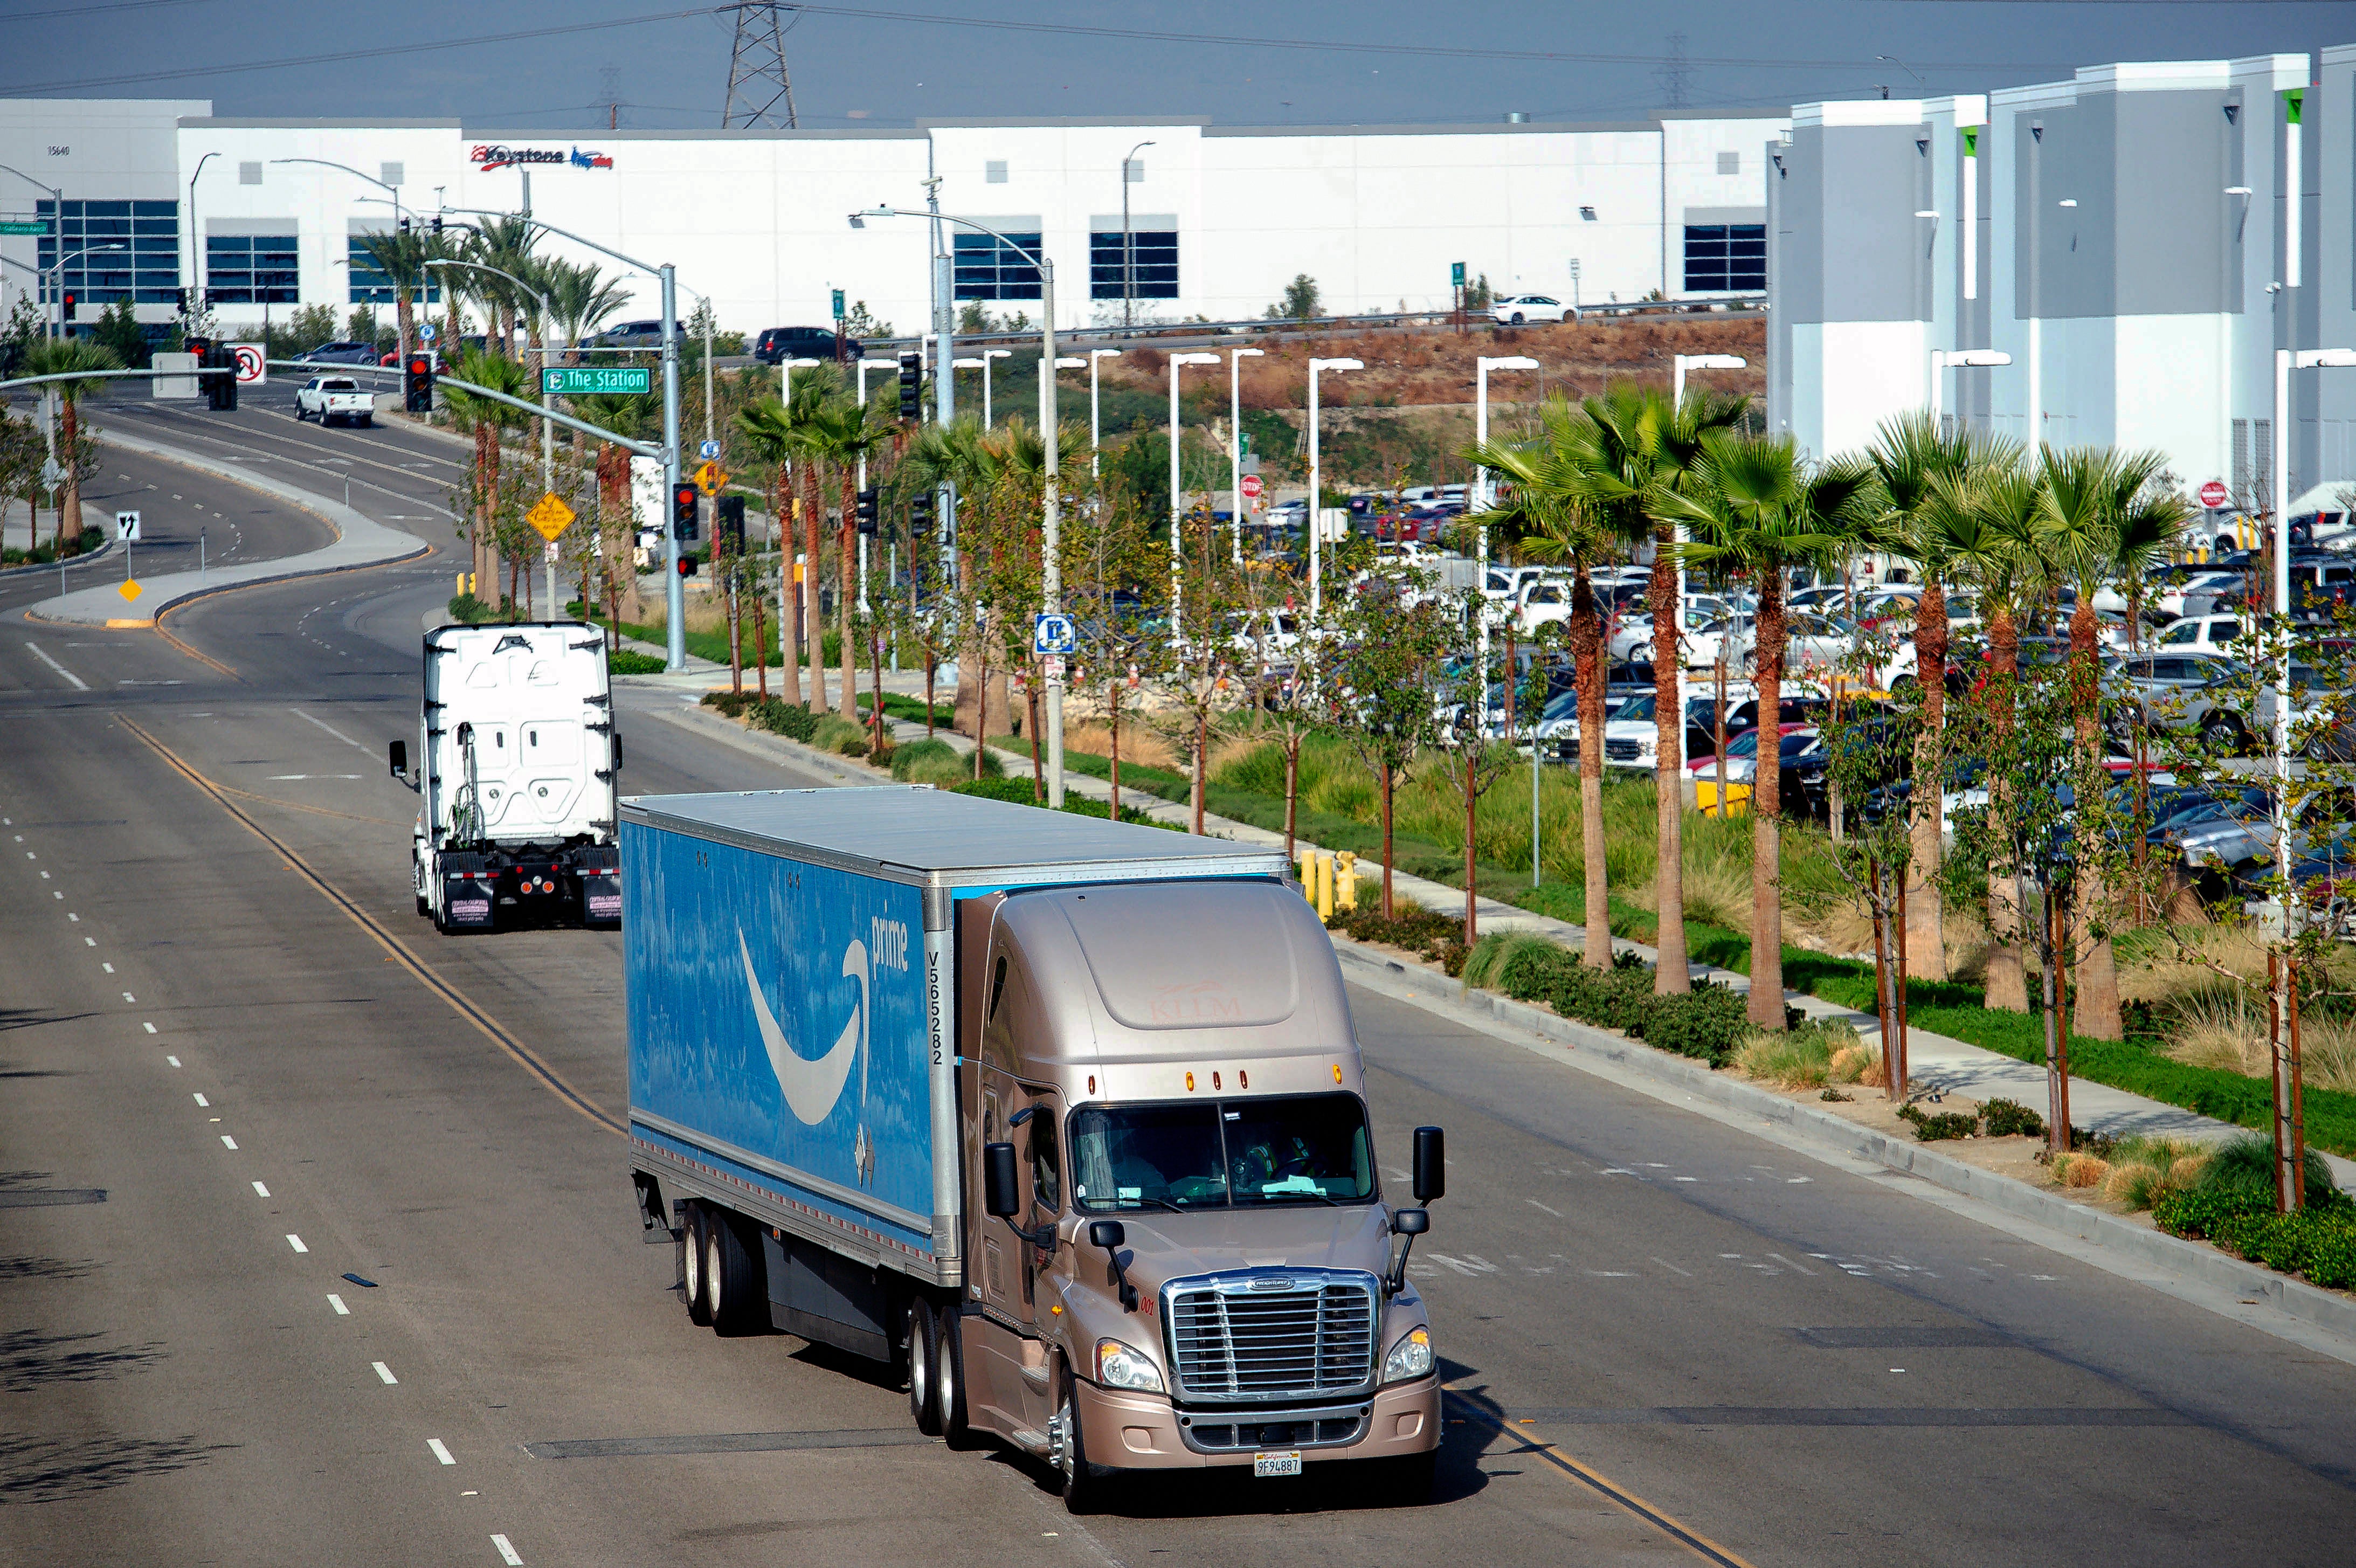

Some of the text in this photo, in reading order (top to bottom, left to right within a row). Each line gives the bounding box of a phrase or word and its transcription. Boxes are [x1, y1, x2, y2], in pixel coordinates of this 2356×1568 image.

[486, 146, 564, 167] Keystone
[568, 370, 644, 387] The Station
[1242, 481, 1260, 492] STOP
[872, 899, 908, 981] prime
[928, 951, 943, 1066] V565282
[1147, 997, 1242, 1020] KLLM
[1141, 1296, 1155, 1316] 001
[1258, 1460, 1298, 1474] 9F94887
